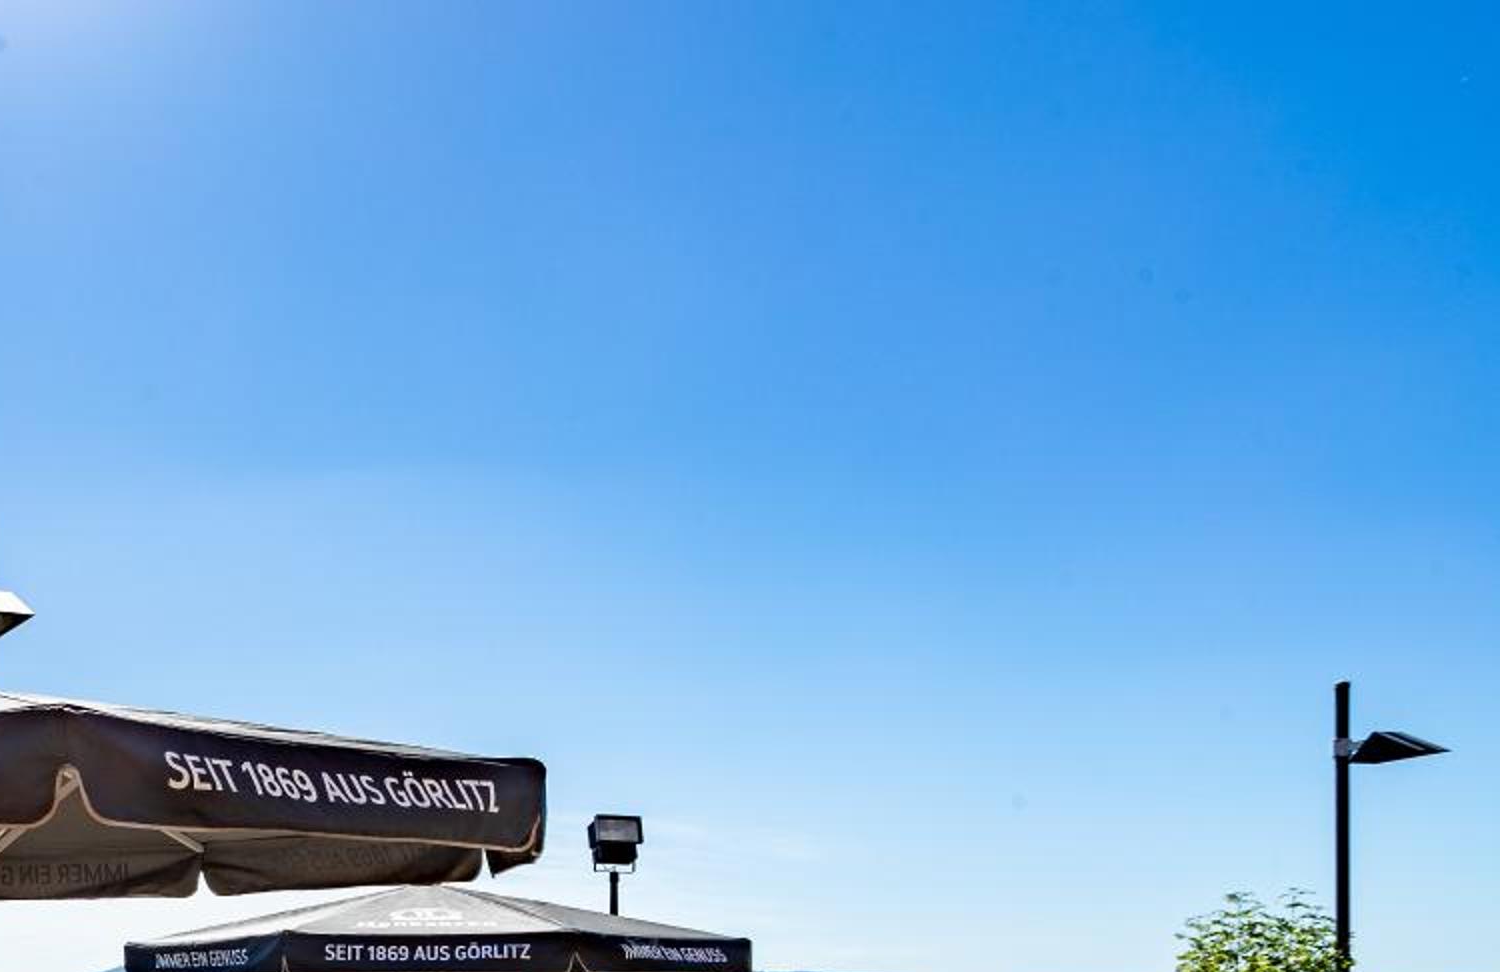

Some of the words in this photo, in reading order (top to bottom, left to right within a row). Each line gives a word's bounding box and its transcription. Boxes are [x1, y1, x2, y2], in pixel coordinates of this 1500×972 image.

[164, 751, 239, 793] SEIT
[241, 761, 318, 803] 1869
[320, 771, 387, 805] AUS
[384, 771, 500, 813] GÖRLITZ
[324, 944, 364, 961] SEIT
[367, 944, 409, 961] 1869
[413, 945, 451, 961] AUS
[455, 941, 532, 960] GÖRLITZ
